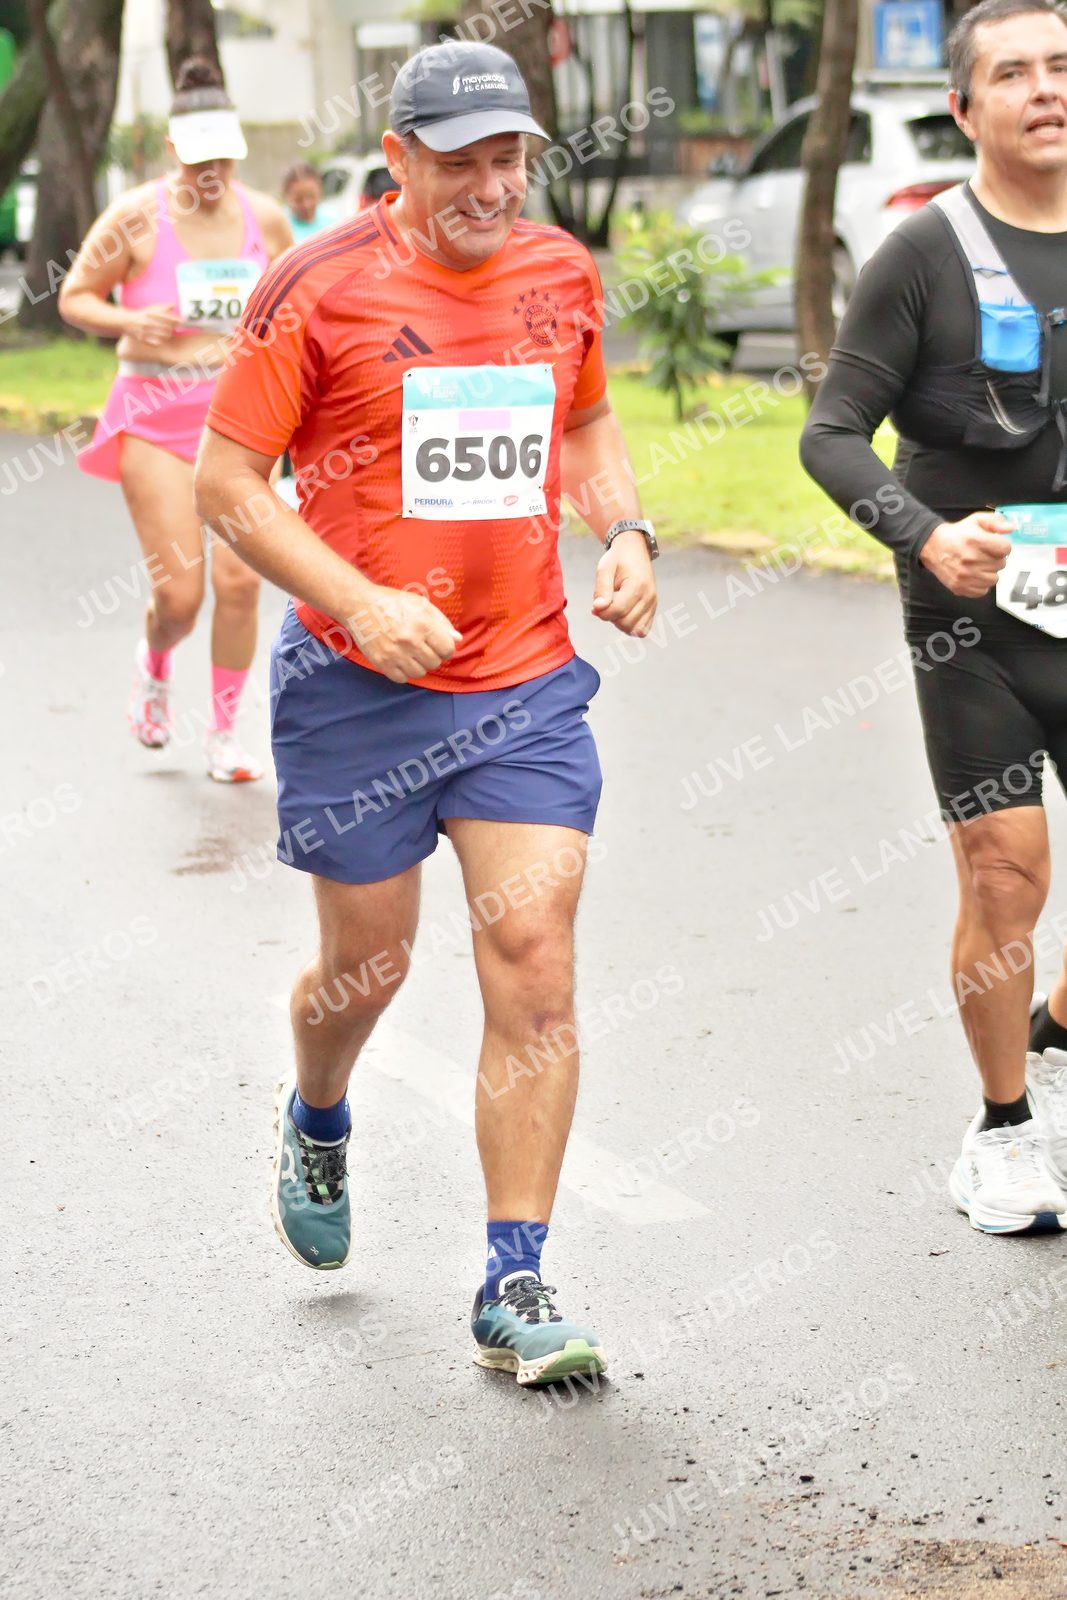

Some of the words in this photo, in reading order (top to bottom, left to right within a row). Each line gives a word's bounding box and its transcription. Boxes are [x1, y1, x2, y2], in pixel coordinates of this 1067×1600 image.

[188, 298, 241, 322] 320
[415, 434, 543, 483] 6506
[414, 497, 454, 506] PERDURA
[1010, 570, 1067, 611] 48
